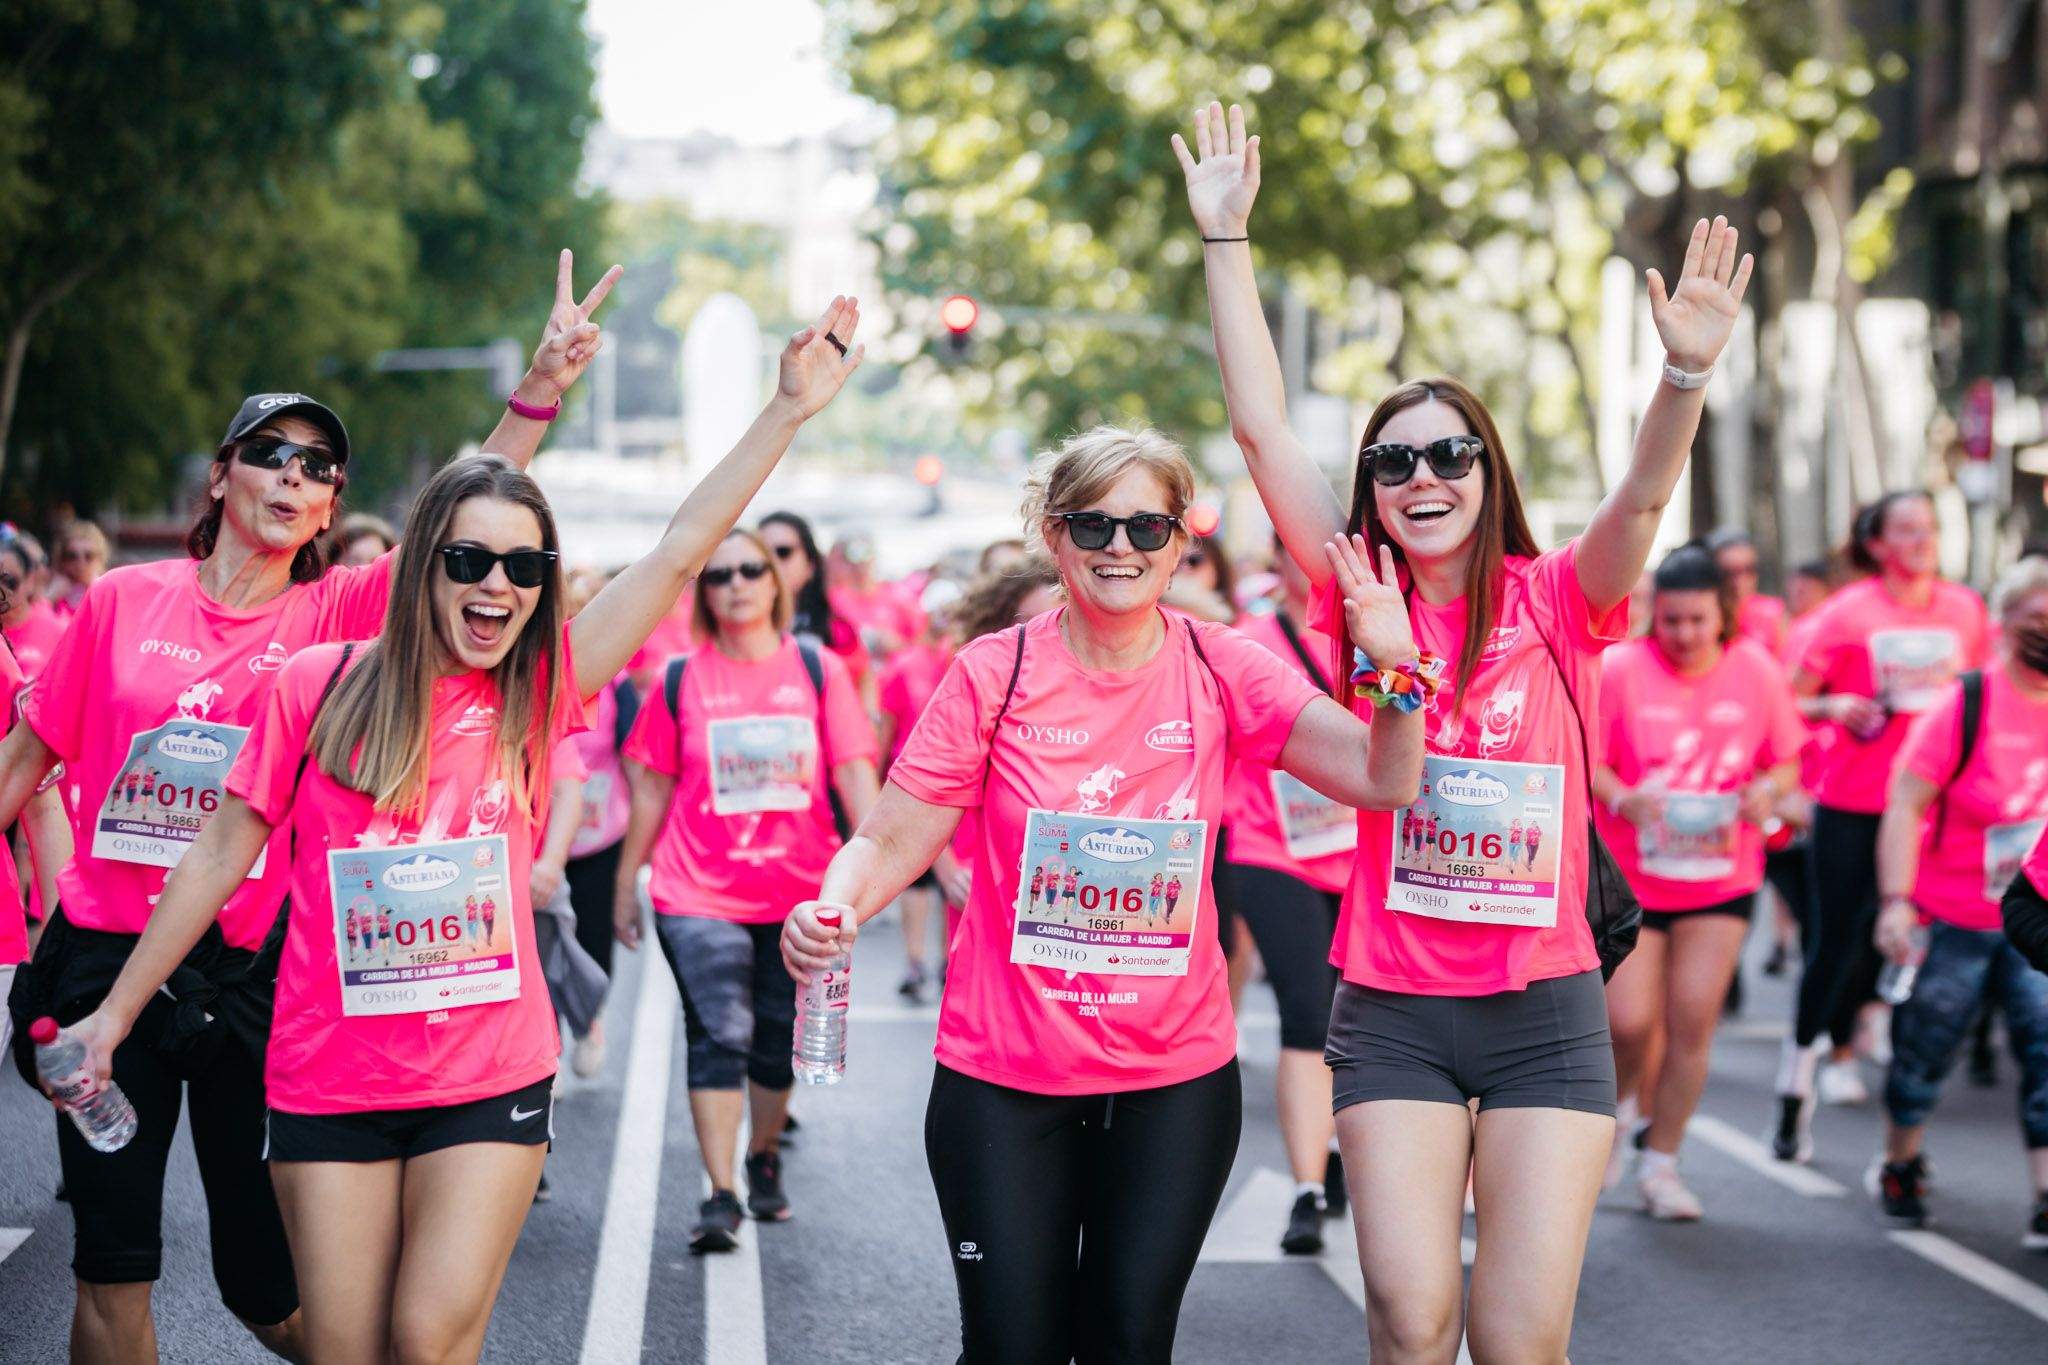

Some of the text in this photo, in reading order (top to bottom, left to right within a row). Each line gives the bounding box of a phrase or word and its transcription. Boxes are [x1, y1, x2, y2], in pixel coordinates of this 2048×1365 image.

[139, 639, 202, 663] OYSHO
[1017, 723, 1090, 745] OYSHO
[1150, 733, 1193, 746] ASTURIA
[162, 740, 223, 759] ASTURIANA
[157, 783, 218, 812] 016
[1440, 780, 1504, 799] ASTURIANA
[116, 821, 200, 839] CARRERA DE LA MUJ
[164, 814, 201, 828] 19863
[1038, 827, 1068, 838] SUMA
[112, 838, 165, 856] OYSHO
[1083, 837, 1149, 856] ASTURIANA
[1438, 830, 1502, 859] 016
[388, 869, 456, 885] ASTURIANA
[1446, 863, 1485, 878] 16963
[1408, 872, 1437, 885] CARRERA
[1438, 877, 1448, 887] DE
[1449, 878, 1461, 888] LA
[1462, 880, 1492, 891] MUJER
[1499, 881, 1536, 894] MADRID
[1079, 885, 1143, 912] 016
[1405, 890, 1448, 909] OYSHO
[1483, 902, 1536, 916] Santander
[394, 915, 462, 947] 016
[1087, 918, 1125, 931] 16961
[1036, 925, 1075, 939] CARRERA
[1076, 930, 1088, 941] DE
[1090, 933, 1101, 942] LA
[1103, 935, 1132, 944] MUJER
[1138, 935, 1172, 945] MADRID
[409, 950, 450, 965] 16962
[1033, 943, 1088, 963] OYSHO
[1121, 955, 1171, 967] Santander
[360, 970, 400, 982] CARRERA
[401, 968, 415, 979] DE
[415, 967, 428, 979] LA
[429, 964, 459, 977] MUJER
[464, 958, 499, 973] MADRID
[360, 987, 417, 1004] OYSHO
[452, 981, 503, 997] Santander
[827, 983, 850, 993] ZER
[1041, 987, 1139, 1005] CARRERA DE LA MUJER
[1078, 1004, 1100, 1018] 2024
